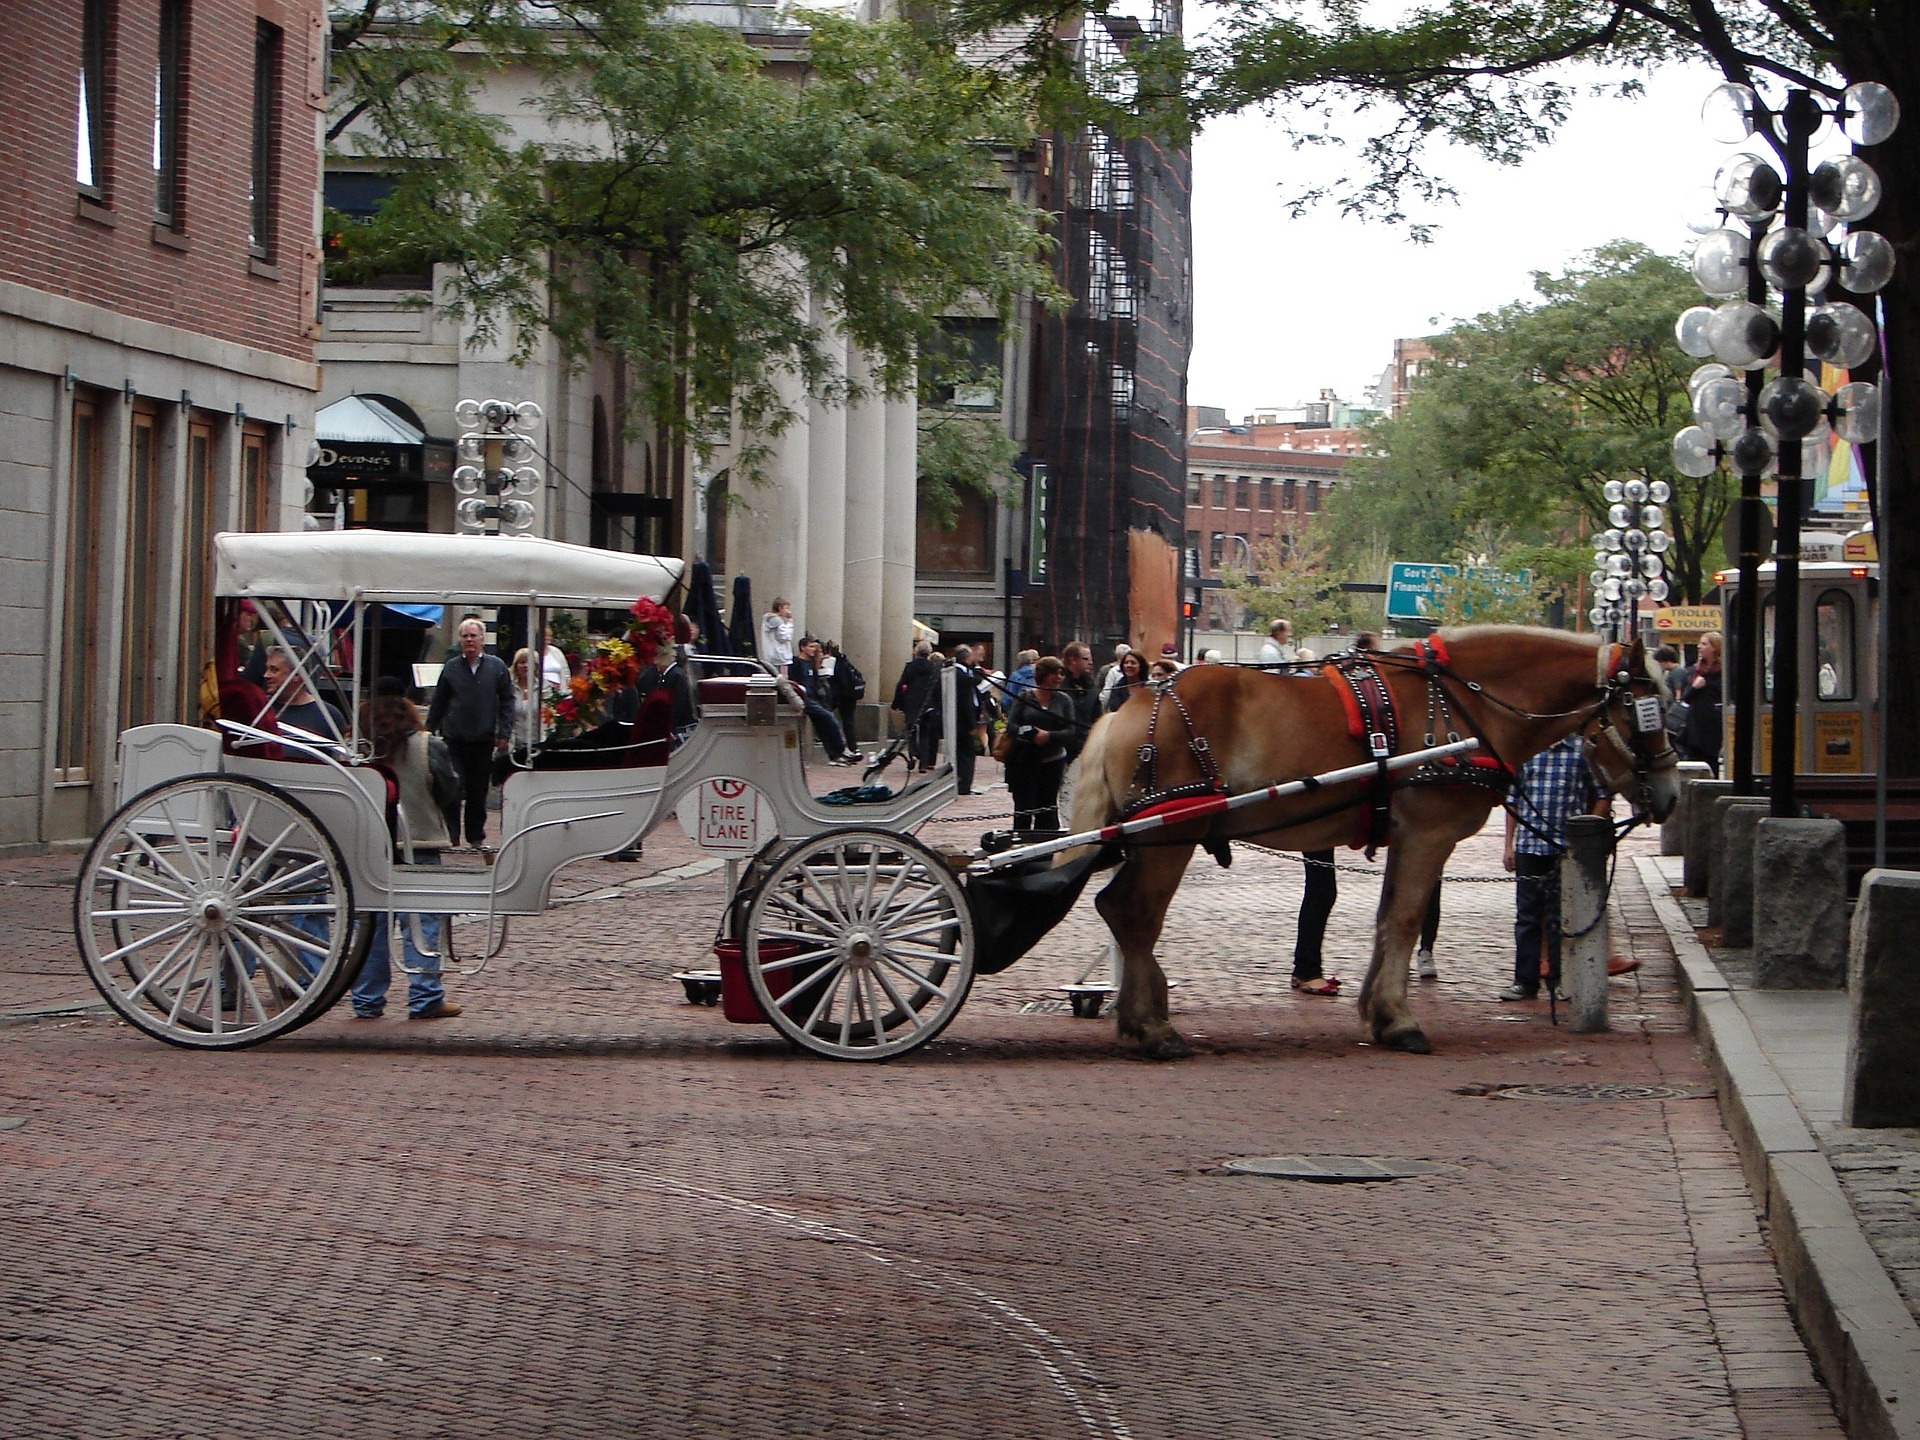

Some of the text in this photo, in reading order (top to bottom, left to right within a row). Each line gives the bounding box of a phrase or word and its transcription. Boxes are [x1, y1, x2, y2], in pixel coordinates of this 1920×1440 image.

[1800, 544, 1834, 552] LLEY
[1677, 619, 1718, 628] TOURS
[711, 805, 745, 820] FIRE
[707, 824, 748, 839] LANE
